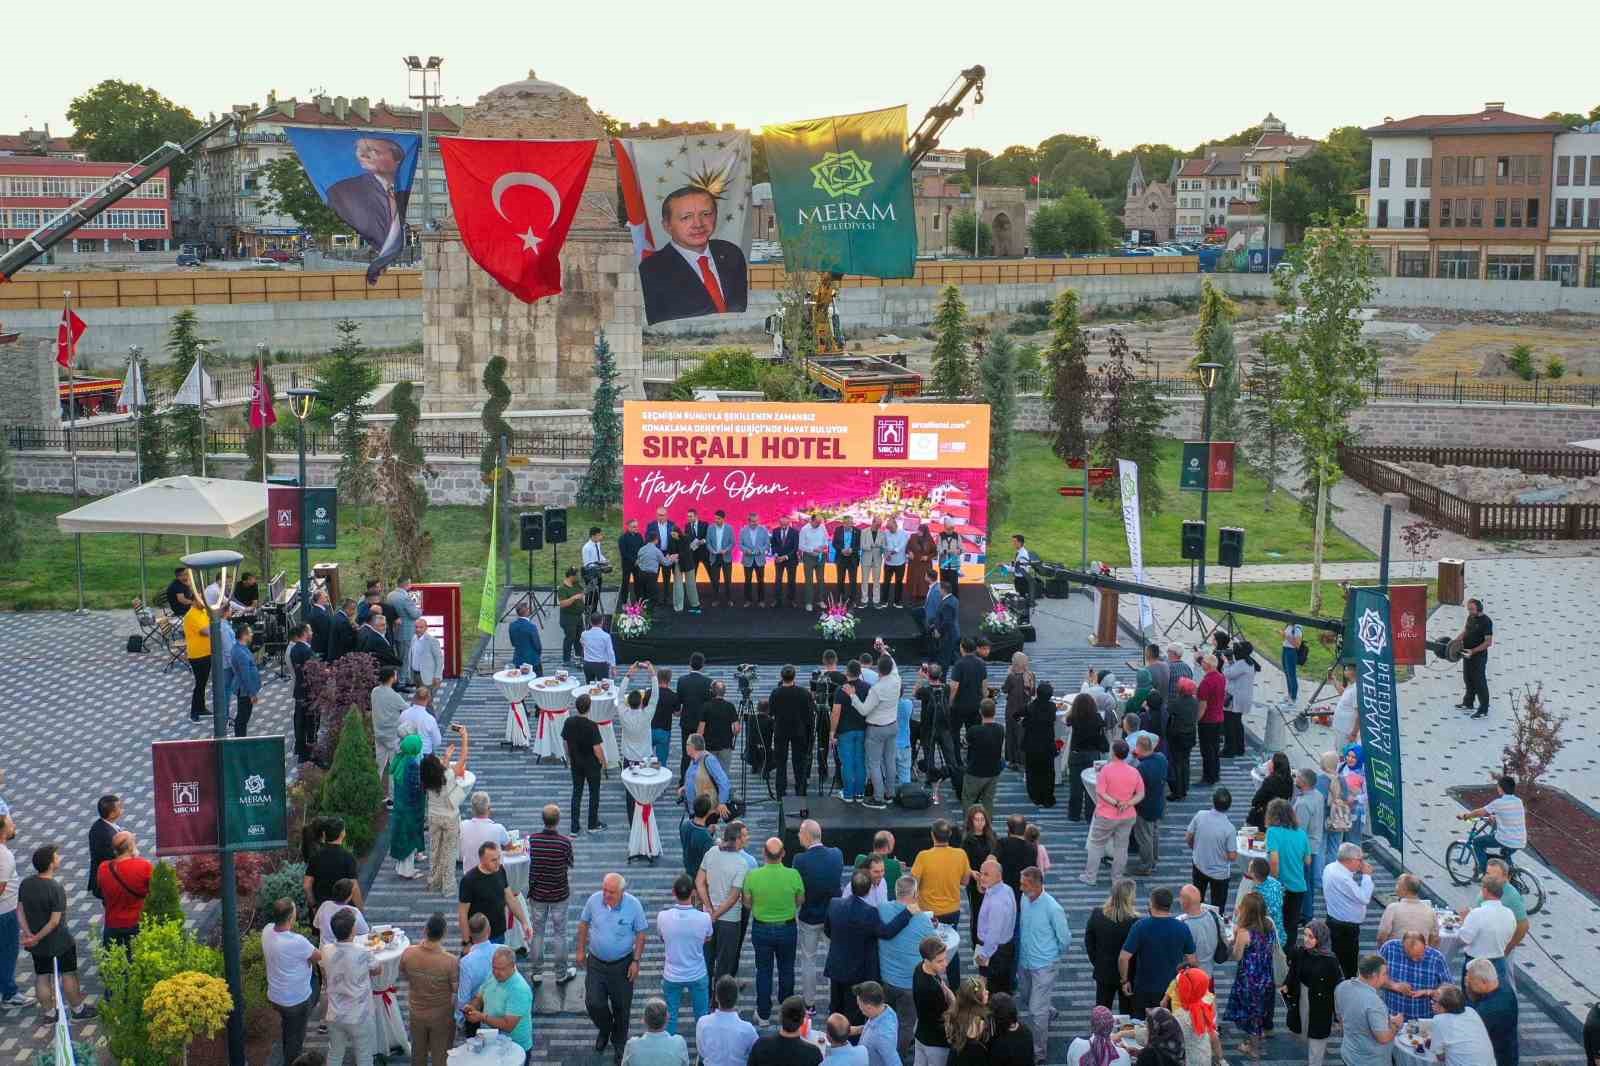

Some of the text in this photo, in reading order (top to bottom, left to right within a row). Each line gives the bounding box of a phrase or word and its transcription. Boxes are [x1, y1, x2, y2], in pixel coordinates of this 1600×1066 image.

[798, 201, 897, 225] MERAM
[642, 435, 847, 465] SIRÇALI HOTEL
[239, 793, 272, 805] MERAM
